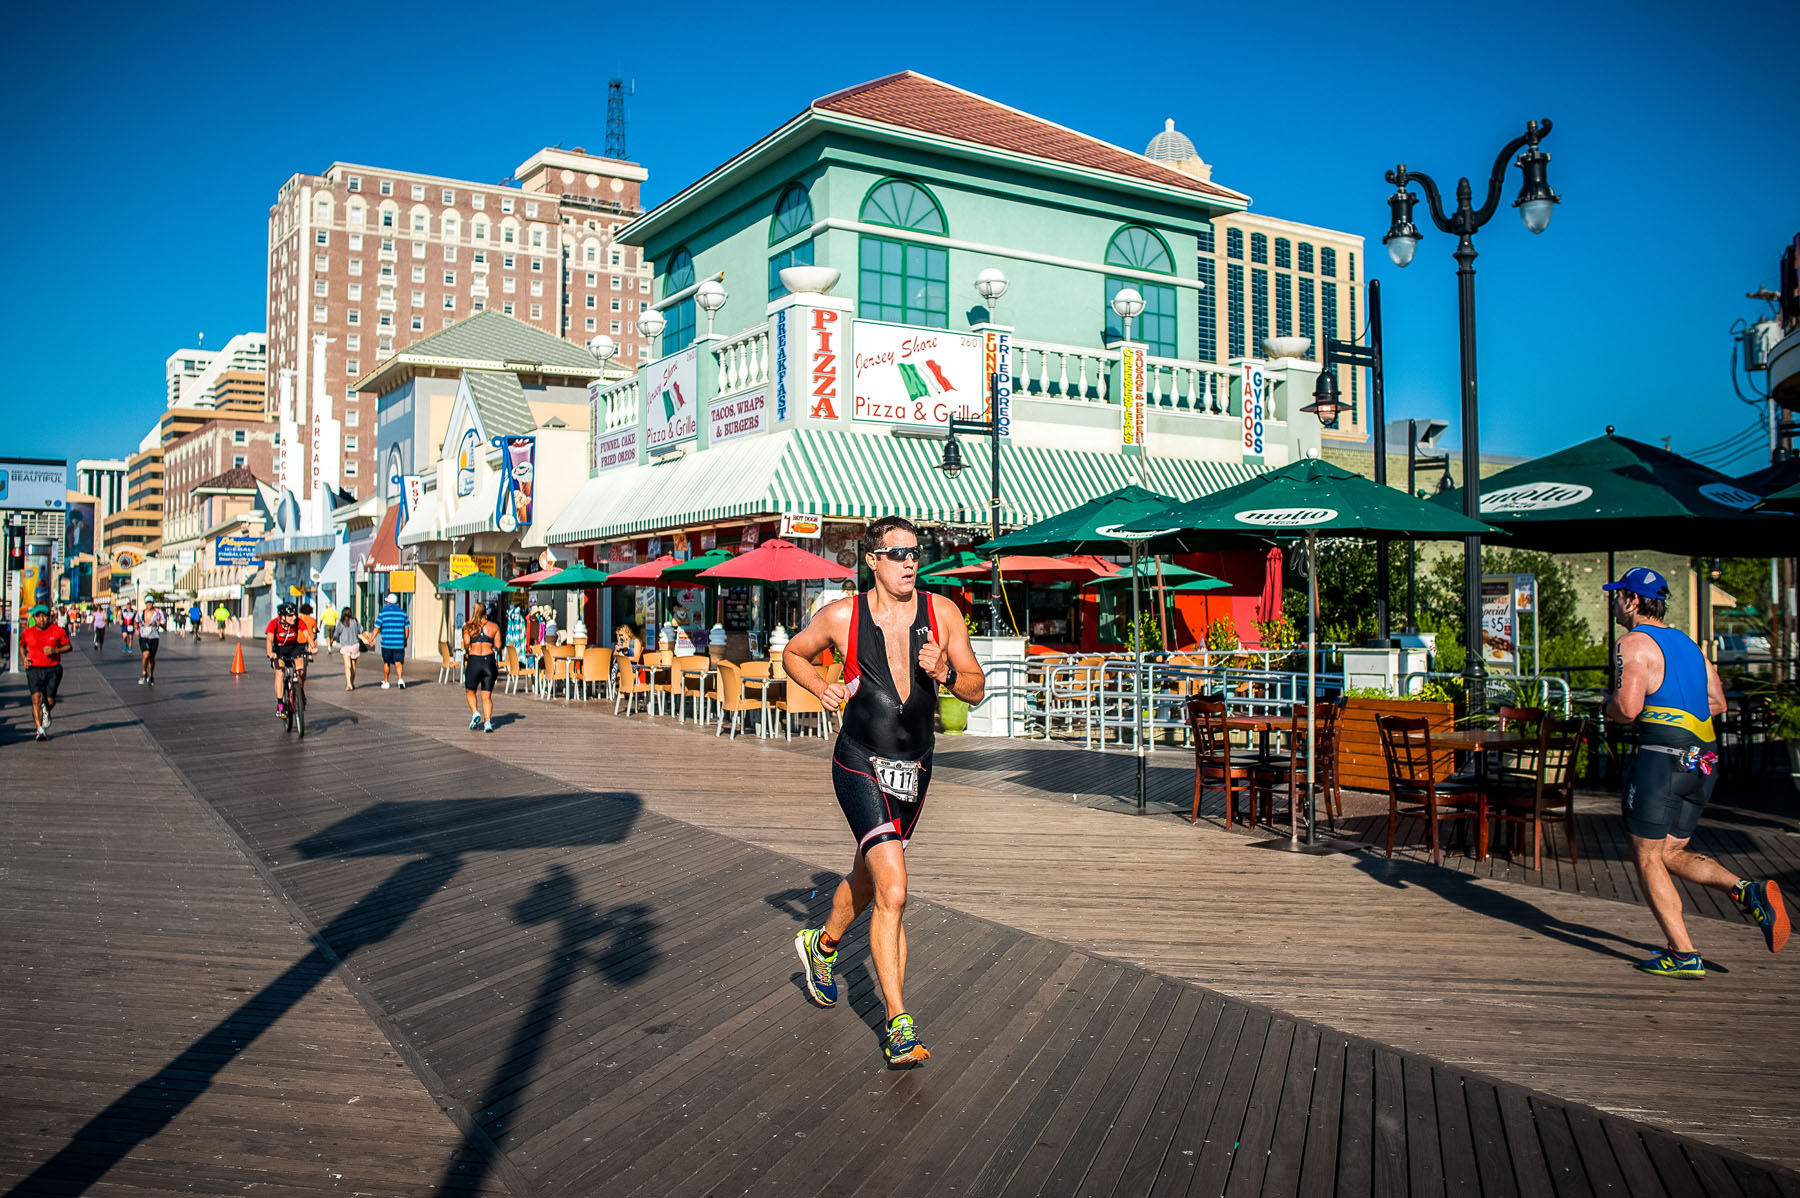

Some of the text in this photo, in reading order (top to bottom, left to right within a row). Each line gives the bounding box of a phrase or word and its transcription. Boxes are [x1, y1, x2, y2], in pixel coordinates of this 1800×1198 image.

[961, 336, 982, 348] 2601
[777, 309, 787, 421] BREAKFAST
[810, 308, 839, 420] PIZZA
[855, 335, 938, 379] Jersey Shore
[1135, 350, 1144, 392] SAUSAGE
[999, 335, 1010, 437] FRIED OREOS
[1123, 348, 1134, 444] CHEESESTEAKS
[711, 395, 765, 422] TACOS, WRAPS
[855, 396, 906, 419] Pizza
[913, 401, 927, 421] &
[1244, 364, 1254, 448] TACOS
[1253, 371, 1264, 454] GYROS
[647, 426, 666, 444] Pizza
[668, 422, 674, 440] &
[716, 415, 759, 438] & BURGERS
[313, 414, 321, 489] ARCADE
[600, 433, 636, 454] FUNNEL CAKE
[601, 448, 636, 468] FRIED OREOS
[11, 473, 63, 484] BEAUTIFUL
[804, 515, 819, 523] DOGS
[1245, 510, 1329, 520] molto
[1483, 605, 1509, 617] pecial
[879, 769, 913, 789] 1117
[1660, 957, 1676, 969] N
